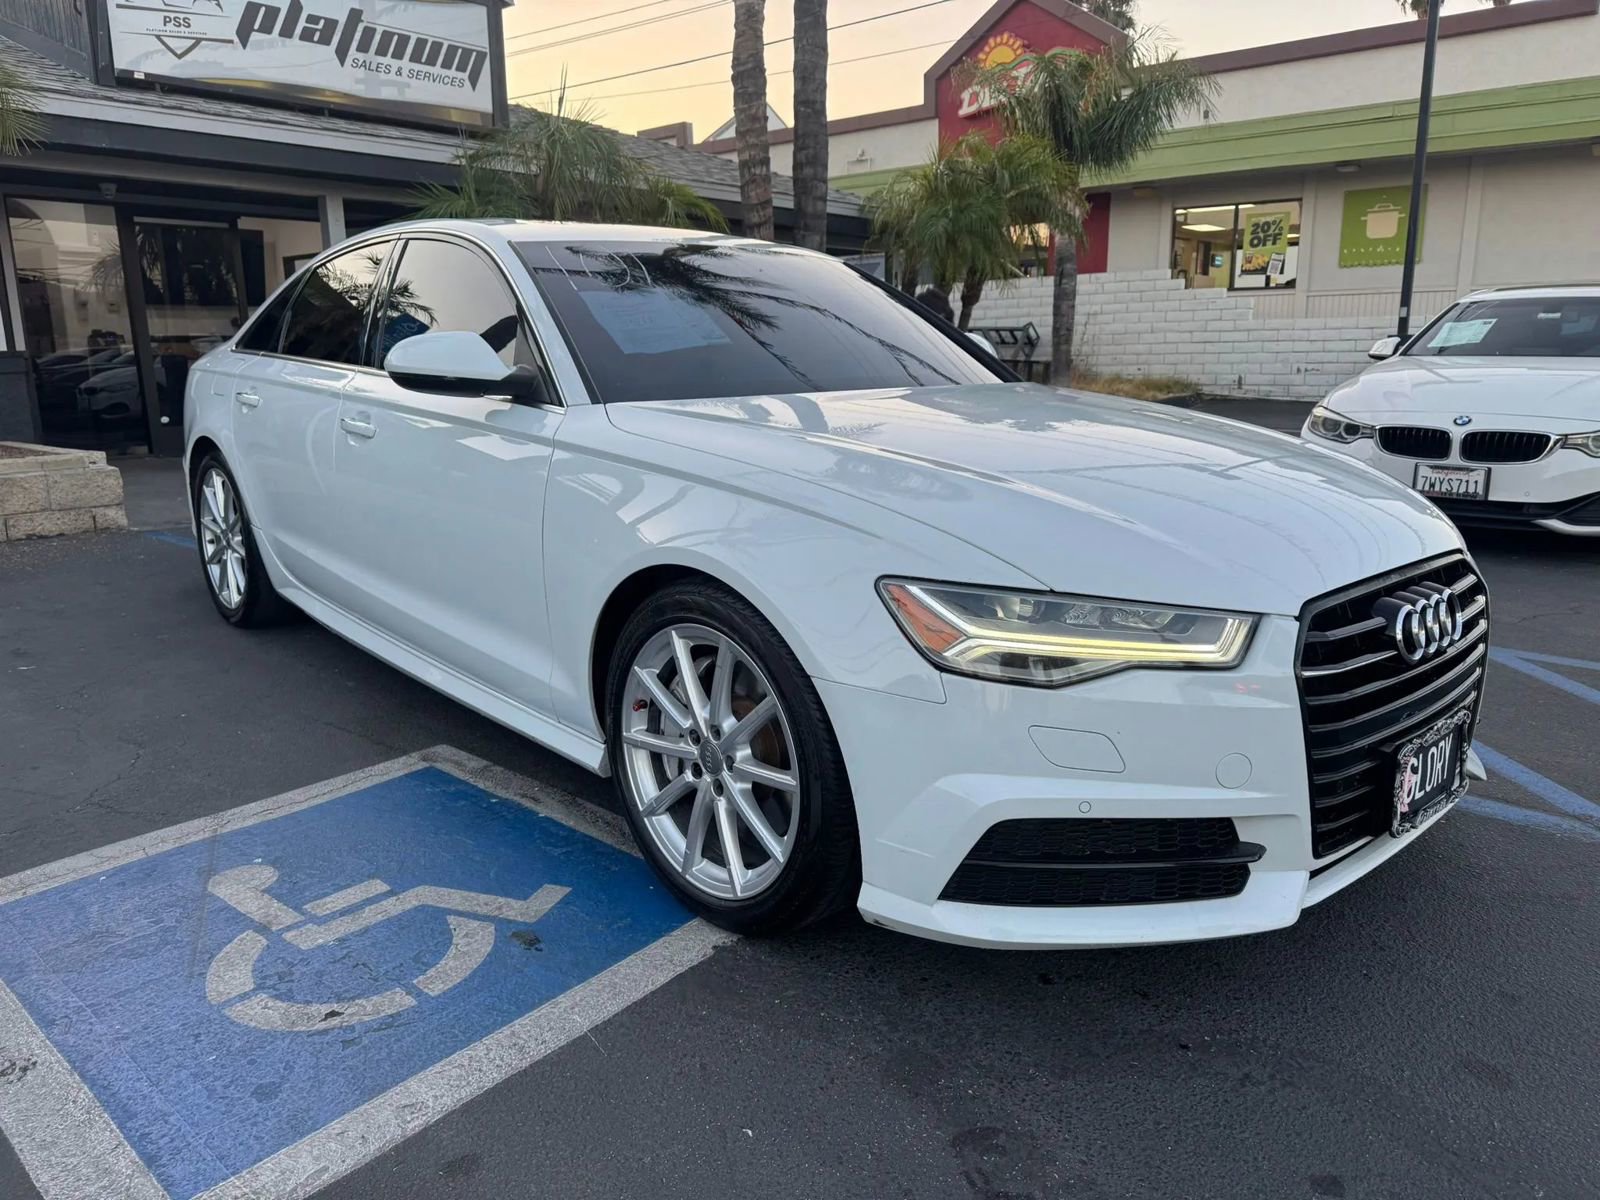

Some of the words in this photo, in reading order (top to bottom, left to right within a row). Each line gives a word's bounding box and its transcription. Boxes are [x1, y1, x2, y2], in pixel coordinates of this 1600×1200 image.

[163, 15, 191, 28] PSS
[351, 57, 391, 75] SALES
[395, 63, 403, 77] &
[408, 68, 466, 89] SERVICES
[1251, 219, 1284, 235] 20%
[1249, 232, 1283, 248] OFF
[1421, 476, 1480, 497] 7WYS711
